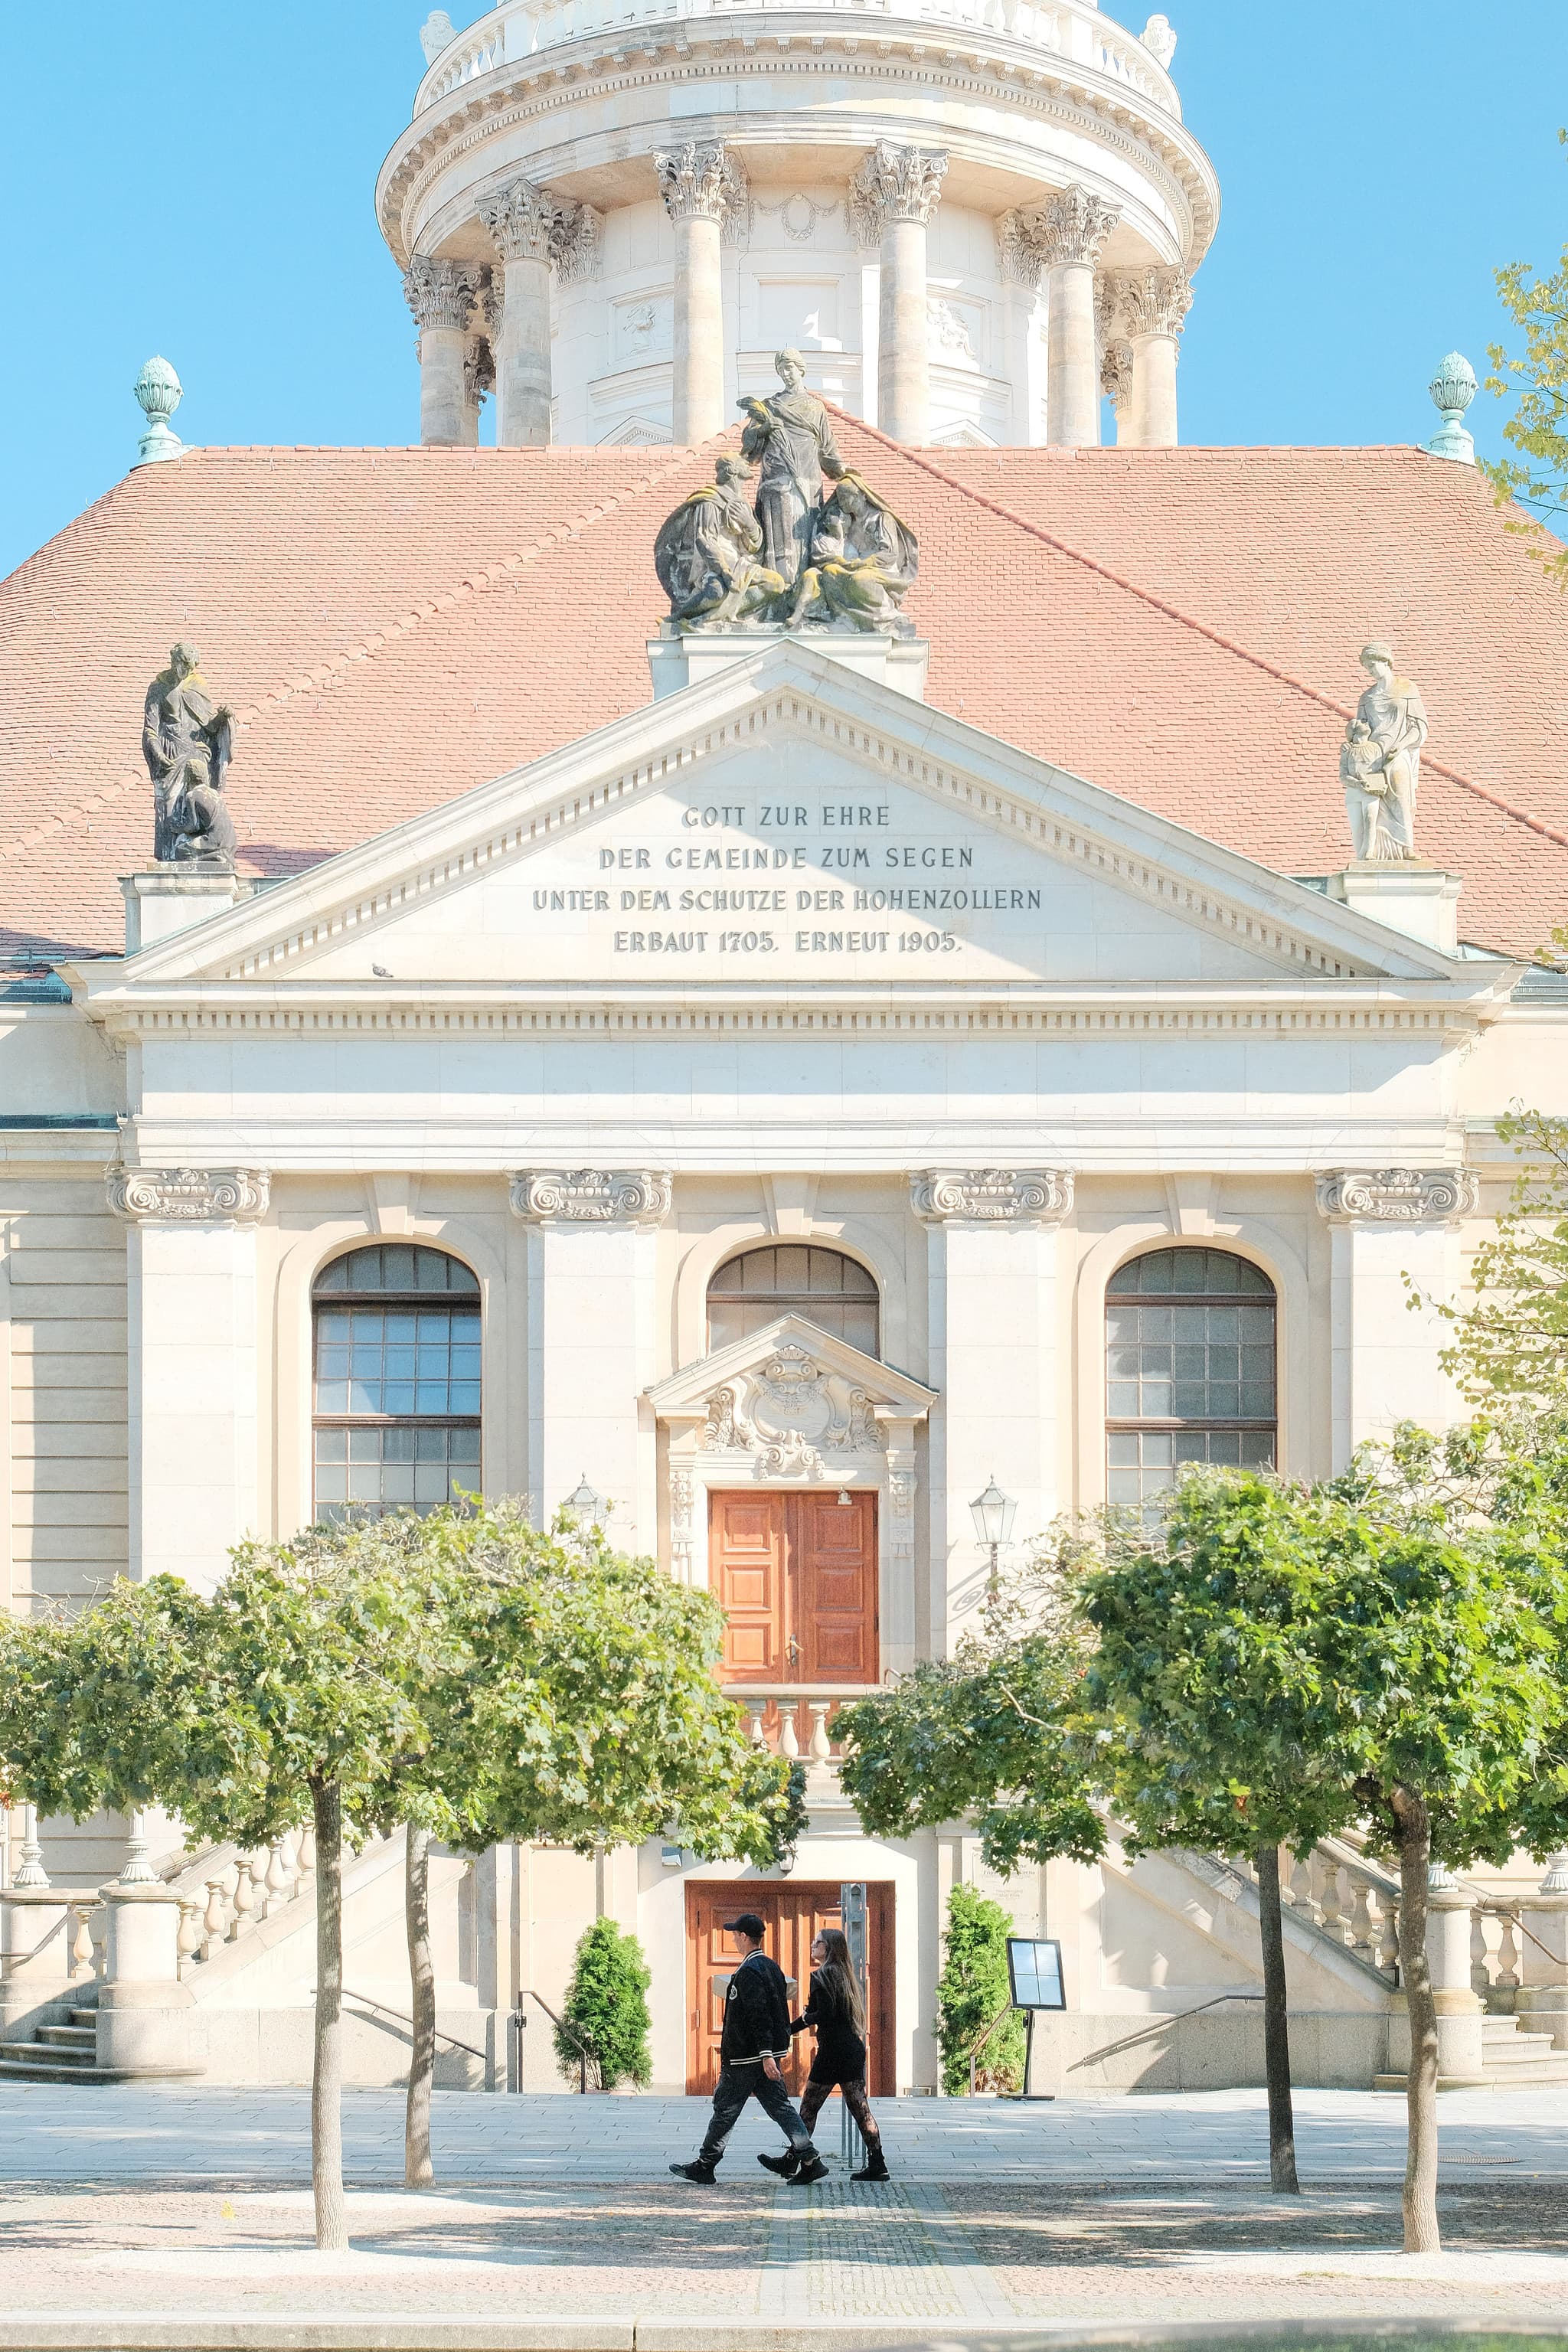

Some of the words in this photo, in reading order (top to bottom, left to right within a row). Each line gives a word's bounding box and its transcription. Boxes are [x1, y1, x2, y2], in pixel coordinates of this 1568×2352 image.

[682, 806, 746, 828] GOTT
[760, 806, 808, 826] ZUR
[823, 806, 890, 826] EHRE
[599, 848, 652, 870] DER
[665, 847, 806, 870] GEMEINDE
[821, 848, 871, 867] ZUM
[886, 848, 973, 867] SEGEN
[532, 890, 610, 912] UNTER
[620, 890, 671, 912] DEM
[678, 890, 787, 912] SCHUTZE
[796, 890, 844, 912] DER
[853, 889, 1042, 911] HOHENZOLLERN
[613, 931, 708, 953] ERBAUT
[718, 931, 779, 953] 1705.
[795, 931, 890, 953] ERNEUT
[898, 931, 963, 953] 1905.
